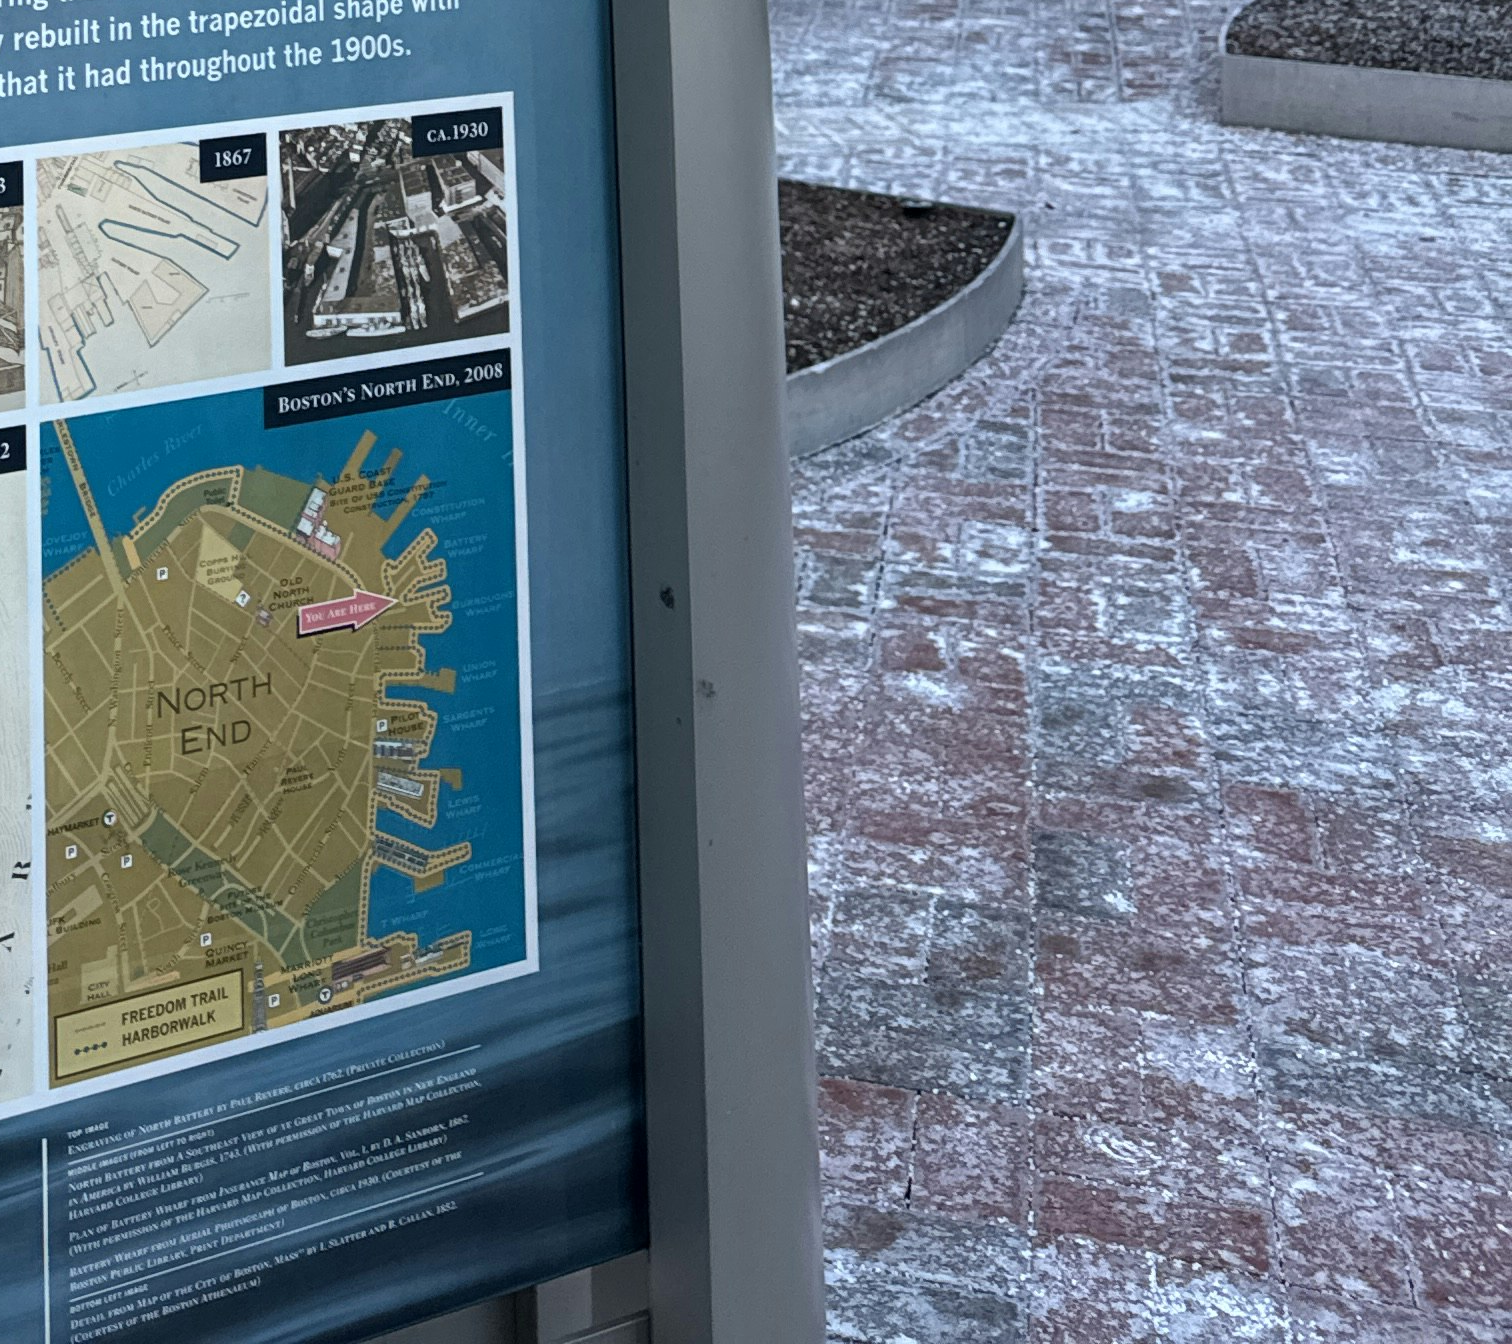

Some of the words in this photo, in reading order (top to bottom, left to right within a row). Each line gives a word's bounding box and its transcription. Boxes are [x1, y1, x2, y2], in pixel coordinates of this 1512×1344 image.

[13, 18, 101, 52] rebuilt
[109, 15, 133, 42] in
[139, 11, 181, 39] the
[57, 65, 77, 92] it
[84, 58, 131, 89] had
[138, 45, 277, 83] throughout
[282, 41, 323, 68] the
[330, 33, 412, 64] 1900s.
[213, 148, 253, 169] 1867
[361, 377, 417, 401] NORTH
[422, 372, 461, 391] END,
[464, 362, 504, 384] 2008
[306, 612, 325, 624] YOU
[327, 608, 347, 619] ARE
[349, 601, 376, 615] HERE
[157, 673, 272, 718] NORTH
[389, 723, 425, 736] HOUSE
[390, 712, 419, 724] PILOT
[182, 720, 251, 754] END
[121, 998, 186, 1025] FREEDOM
[191, 987, 229, 1007] TRAIL
[121, 1010, 216, 1046] HARBORWALK
